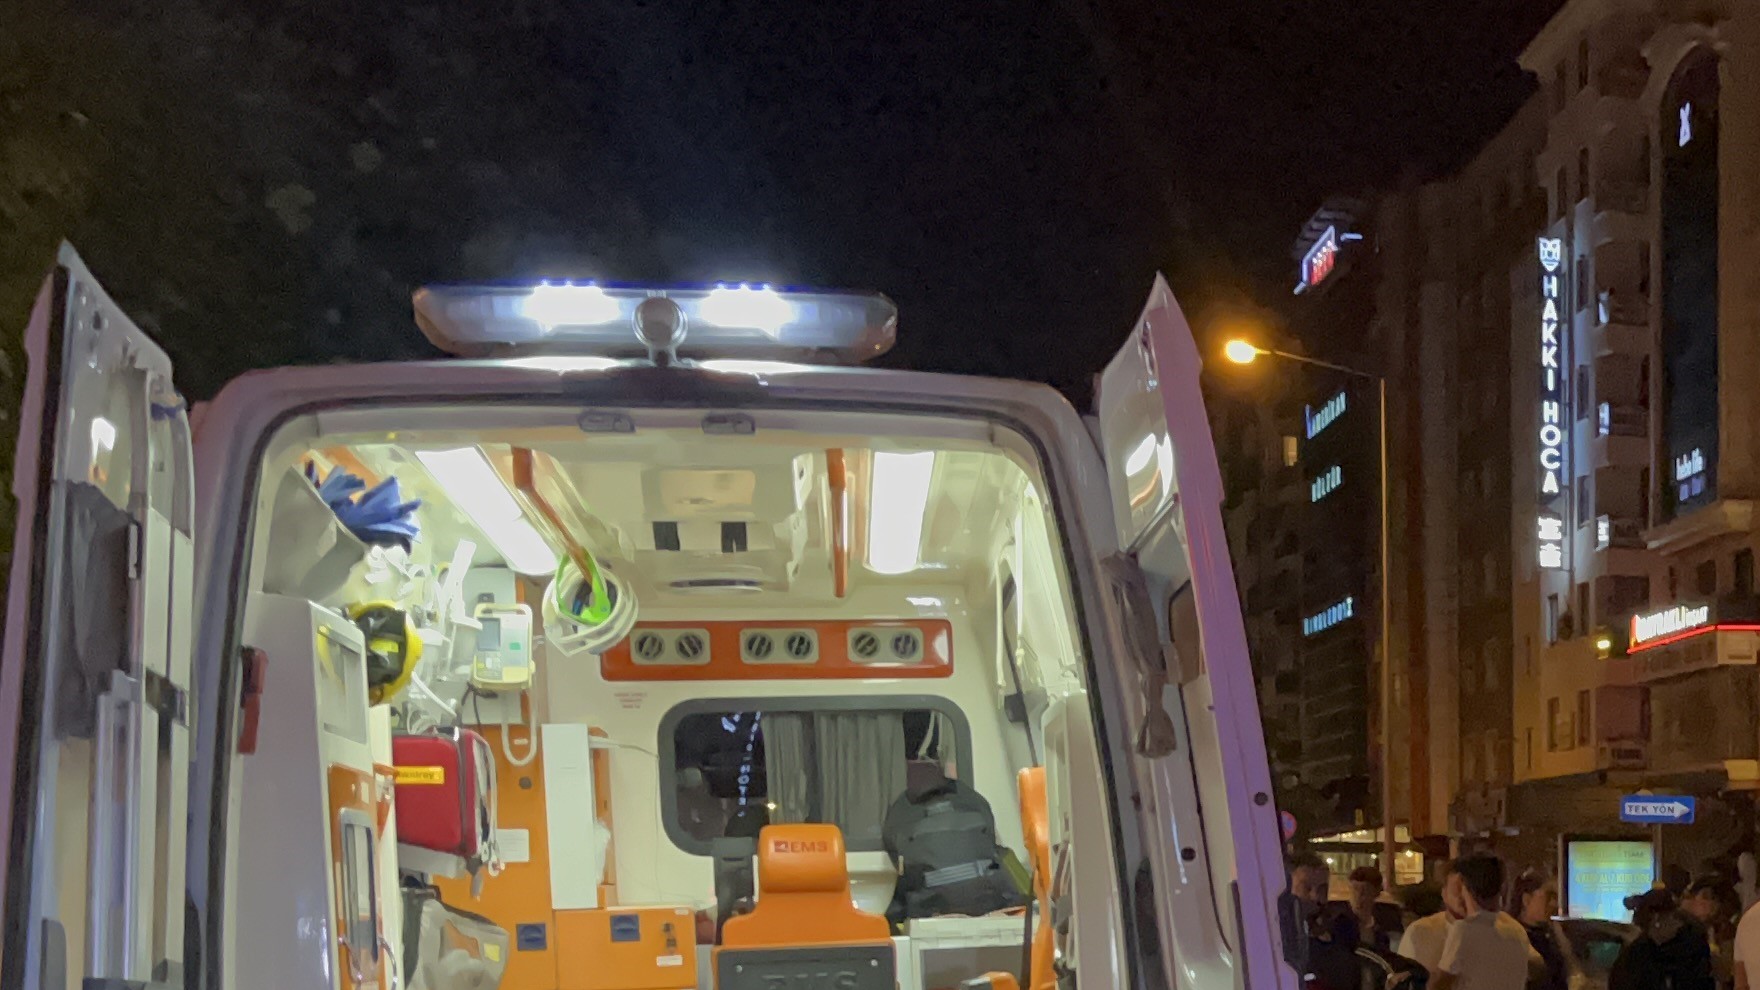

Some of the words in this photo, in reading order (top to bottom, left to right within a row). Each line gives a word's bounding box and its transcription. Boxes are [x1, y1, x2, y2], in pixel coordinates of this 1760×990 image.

[1541, 275, 1558, 391] HAKKI
[1540, 400, 1561, 493] HOCA
[1627, 804, 1648, 814] TEK
[790, 840, 827, 853] EMS
